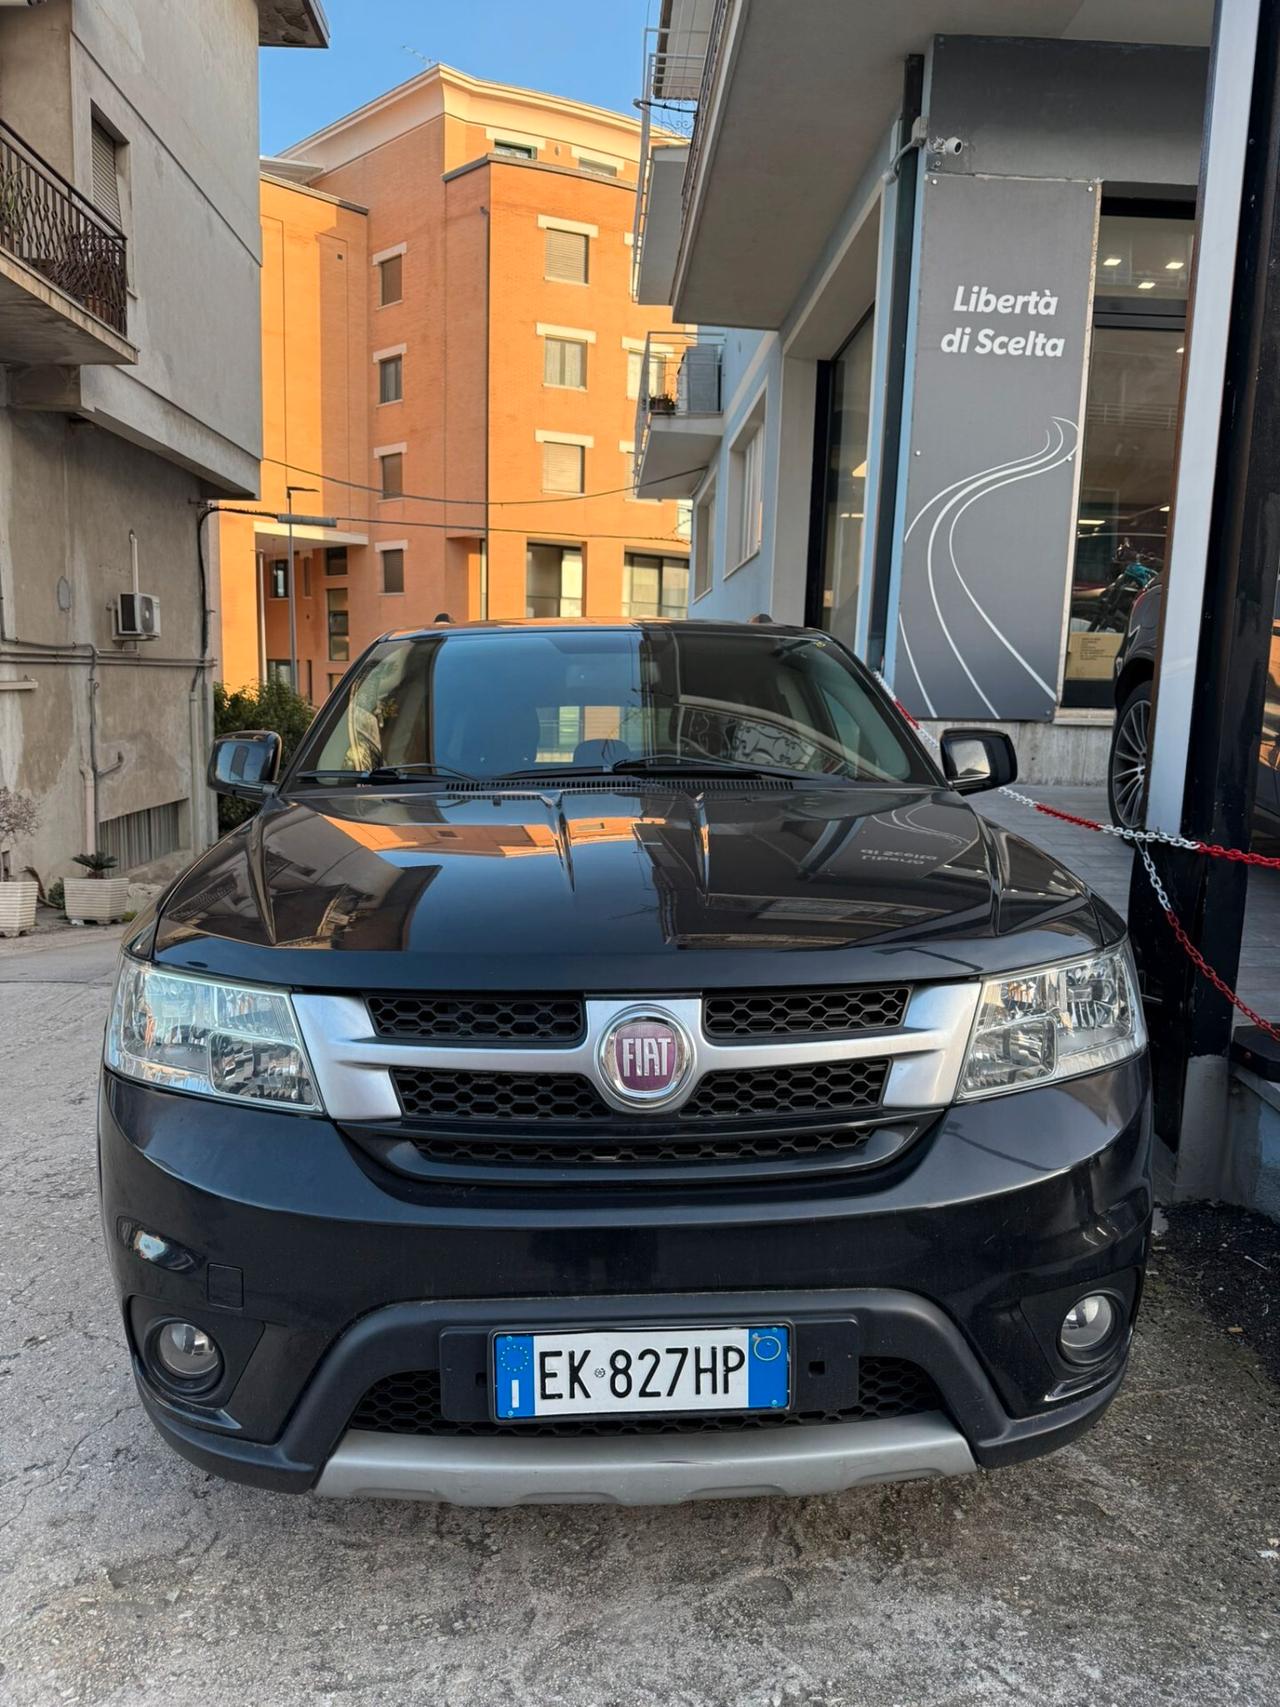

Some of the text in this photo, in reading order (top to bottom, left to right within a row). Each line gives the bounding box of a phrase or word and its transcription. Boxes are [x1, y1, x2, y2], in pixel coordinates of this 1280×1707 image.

[953, 285, 1059, 315] Libertà
[940, 326, 1066, 357] di Scelta
[622, 1037, 671, 1077] FIAT
